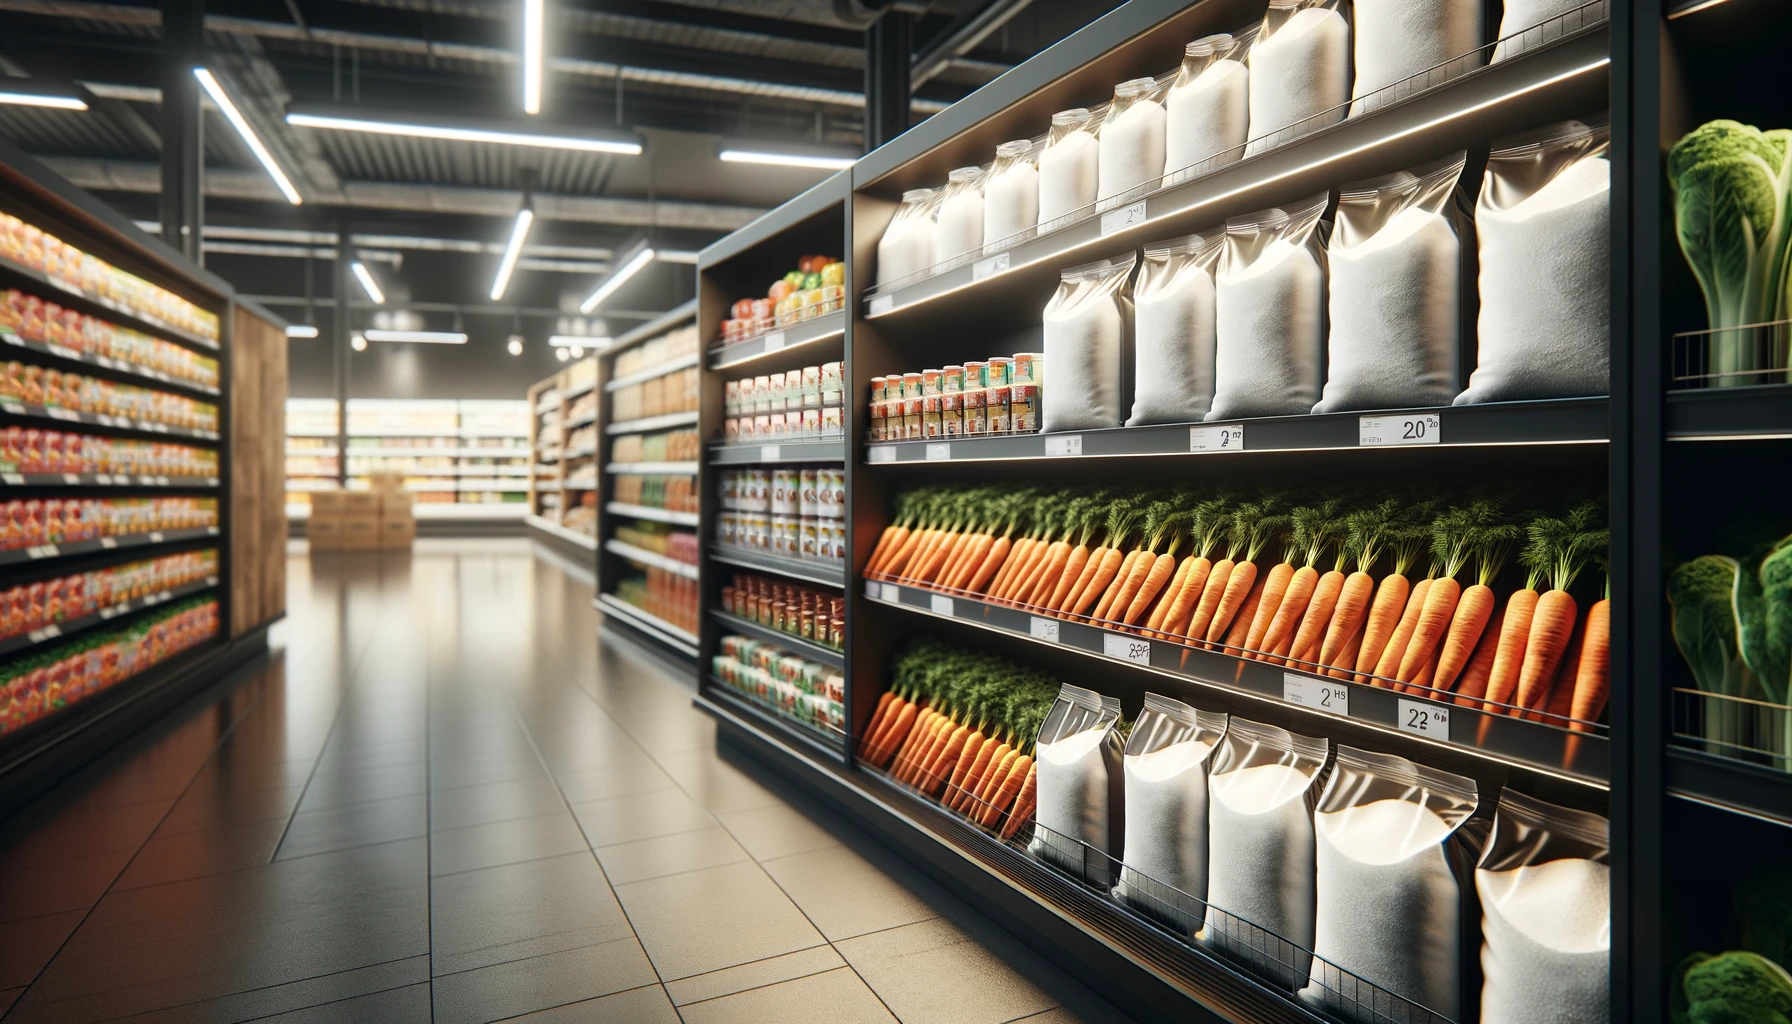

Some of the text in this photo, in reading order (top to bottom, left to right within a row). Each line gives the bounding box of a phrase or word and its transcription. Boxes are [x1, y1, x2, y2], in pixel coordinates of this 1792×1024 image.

[1402, 420, 1425, 440] 20
[1321, 687, 1331, 708] 2
[1407, 708, 1428, 730] 22
